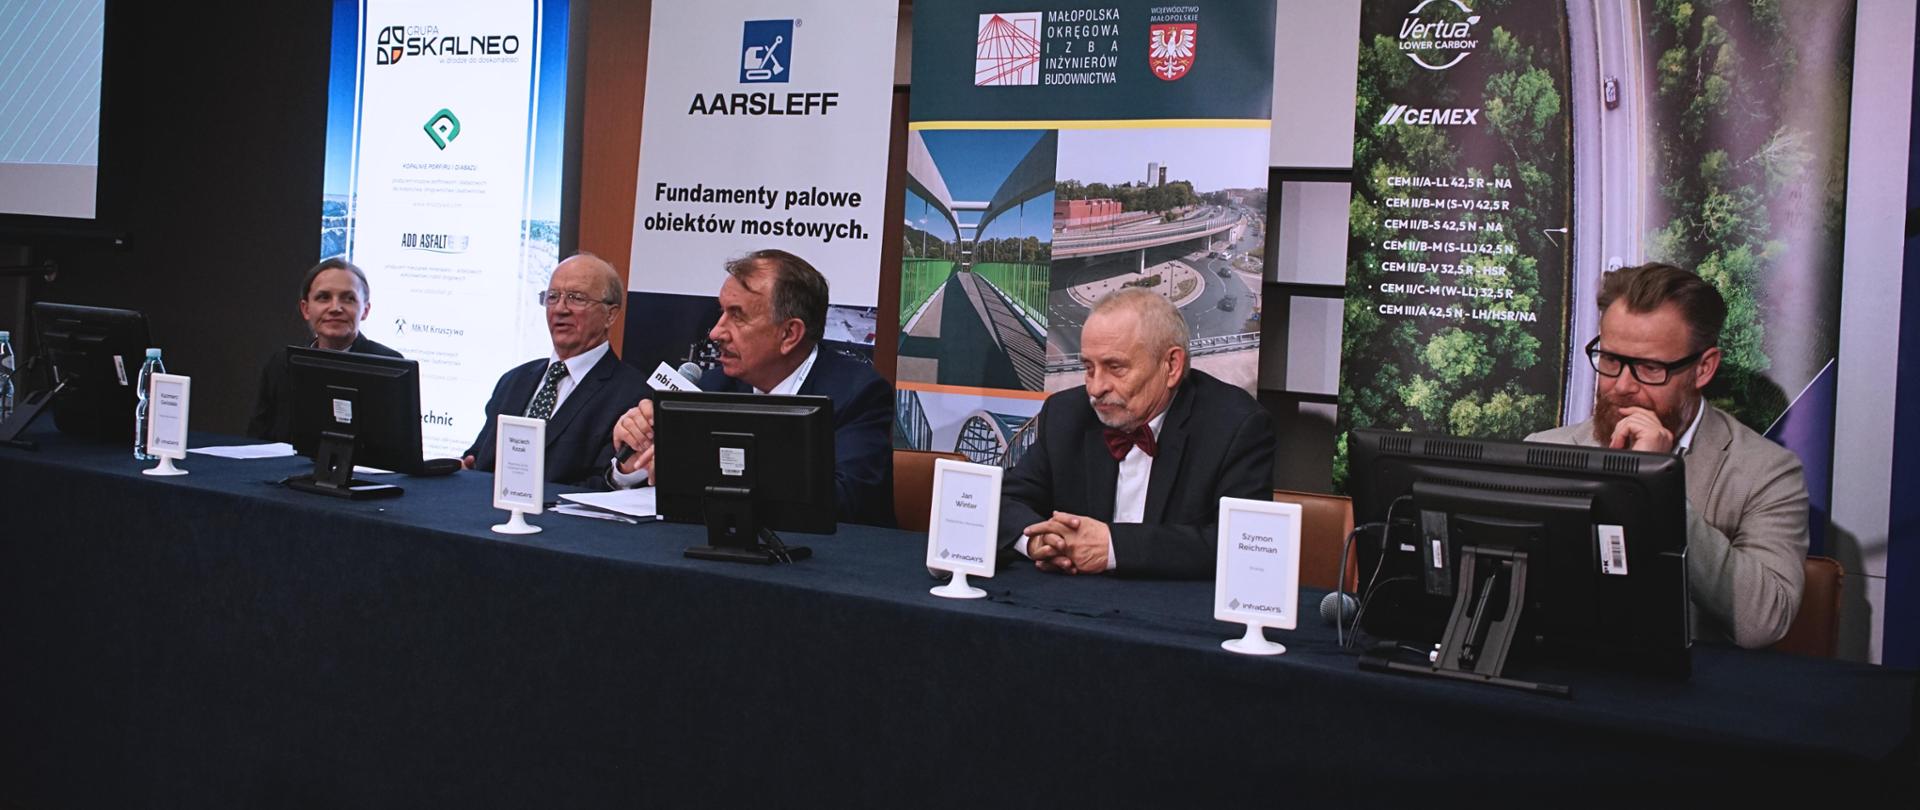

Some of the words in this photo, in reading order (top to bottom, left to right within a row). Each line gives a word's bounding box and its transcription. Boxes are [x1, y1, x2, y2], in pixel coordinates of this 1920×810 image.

[1048, 8, 1120, 22] MAŁOPOLSKA
[407, 26, 439, 36] GRUPA
[1047, 25, 1119, 40] OKRĘGOWA
[1400, 17, 1470, 38] Vertua
[407, 36, 519, 56] SKALNEO
[1400, 41, 1432, 50] LOWER
[1045, 56, 1117, 69] INŻYNIERÓW
[1045, 72, 1116, 85] BUDOWNICTWA
[688, 92, 838, 115] AARSLEFF
[1404, 109, 1480, 125] CEMEX
[1387, 177, 1411, 186] CEM
[1413, 177, 1449, 187] II/A-LL
[1451, 178, 1474, 188] 42,5
[1477, 178, 1484, 187] R
[1495, 179, 1512, 189] NA
[655, 183, 778, 209] Fundamenty
[785, 187, 862, 210] palowe
[1386, 198, 1409, 207] CEM
[1412, 199, 1445, 209] II/B-M
[1447, 199, 1474, 210] (S-V)
[1476, 200, 1500, 211] 42,5
[1502, 201, 1509, 210] R
[644, 213, 735, 234] obiektów
[741, 218, 868, 243] mostowych.
[1384, 219, 1408, 229] CEM
[1410, 220, 1440, 230] II/B-S
[1443, 221, 1466, 232] 42,5
[1468, 222, 1476, 231] N
[1487, 222, 1503, 232] NA
[402, 234, 417, 247] ADD
[420, 234, 448, 249] ASFALT
[1383, 241, 1407, 250] CEM
[1409, 241, 1443, 252] II/B-M
[1444, 243, 1477, 253] (S-LL)
[1479, 244, 1503, 254] 42,5
[1505, 245, 1513, 254] N
[1382, 262, 1405, 271] CEM
[1408, 263, 1439, 273] II/B-V
[1441, 264, 1464, 275] 32,5
[1466, 265, 1473, 274] R
[1483, 266, 1506, 276] HSR
[1381, 283, 1404, 293] CEM
[1406, 284, 1440, 295] II/C-M
[1441, 286, 1478, 297] (W-LL)
[1480, 288, 1503, 299] 32,5
[1505, 289, 1513, 298] R
[1379, 304, 1403, 314] CEM
[1405, 305, 1427, 316] III/A
[1429, 307, 1452, 318] 42,5
[1454, 308, 1463, 317] N
[1472, 310, 1537, 322] LH/HSR/NA
[431, 324, 464, 336] Kruszywa
[656, 373, 672, 386] nbi
[421, 411, 453, 426] chnic
[956, 500, 977, 509] Winter
[1242, 533, 1273, 542] Szymon
[1238, 543, 1277, 553] Reichman
[1243, 603, 1281, 613] infraDAYS
